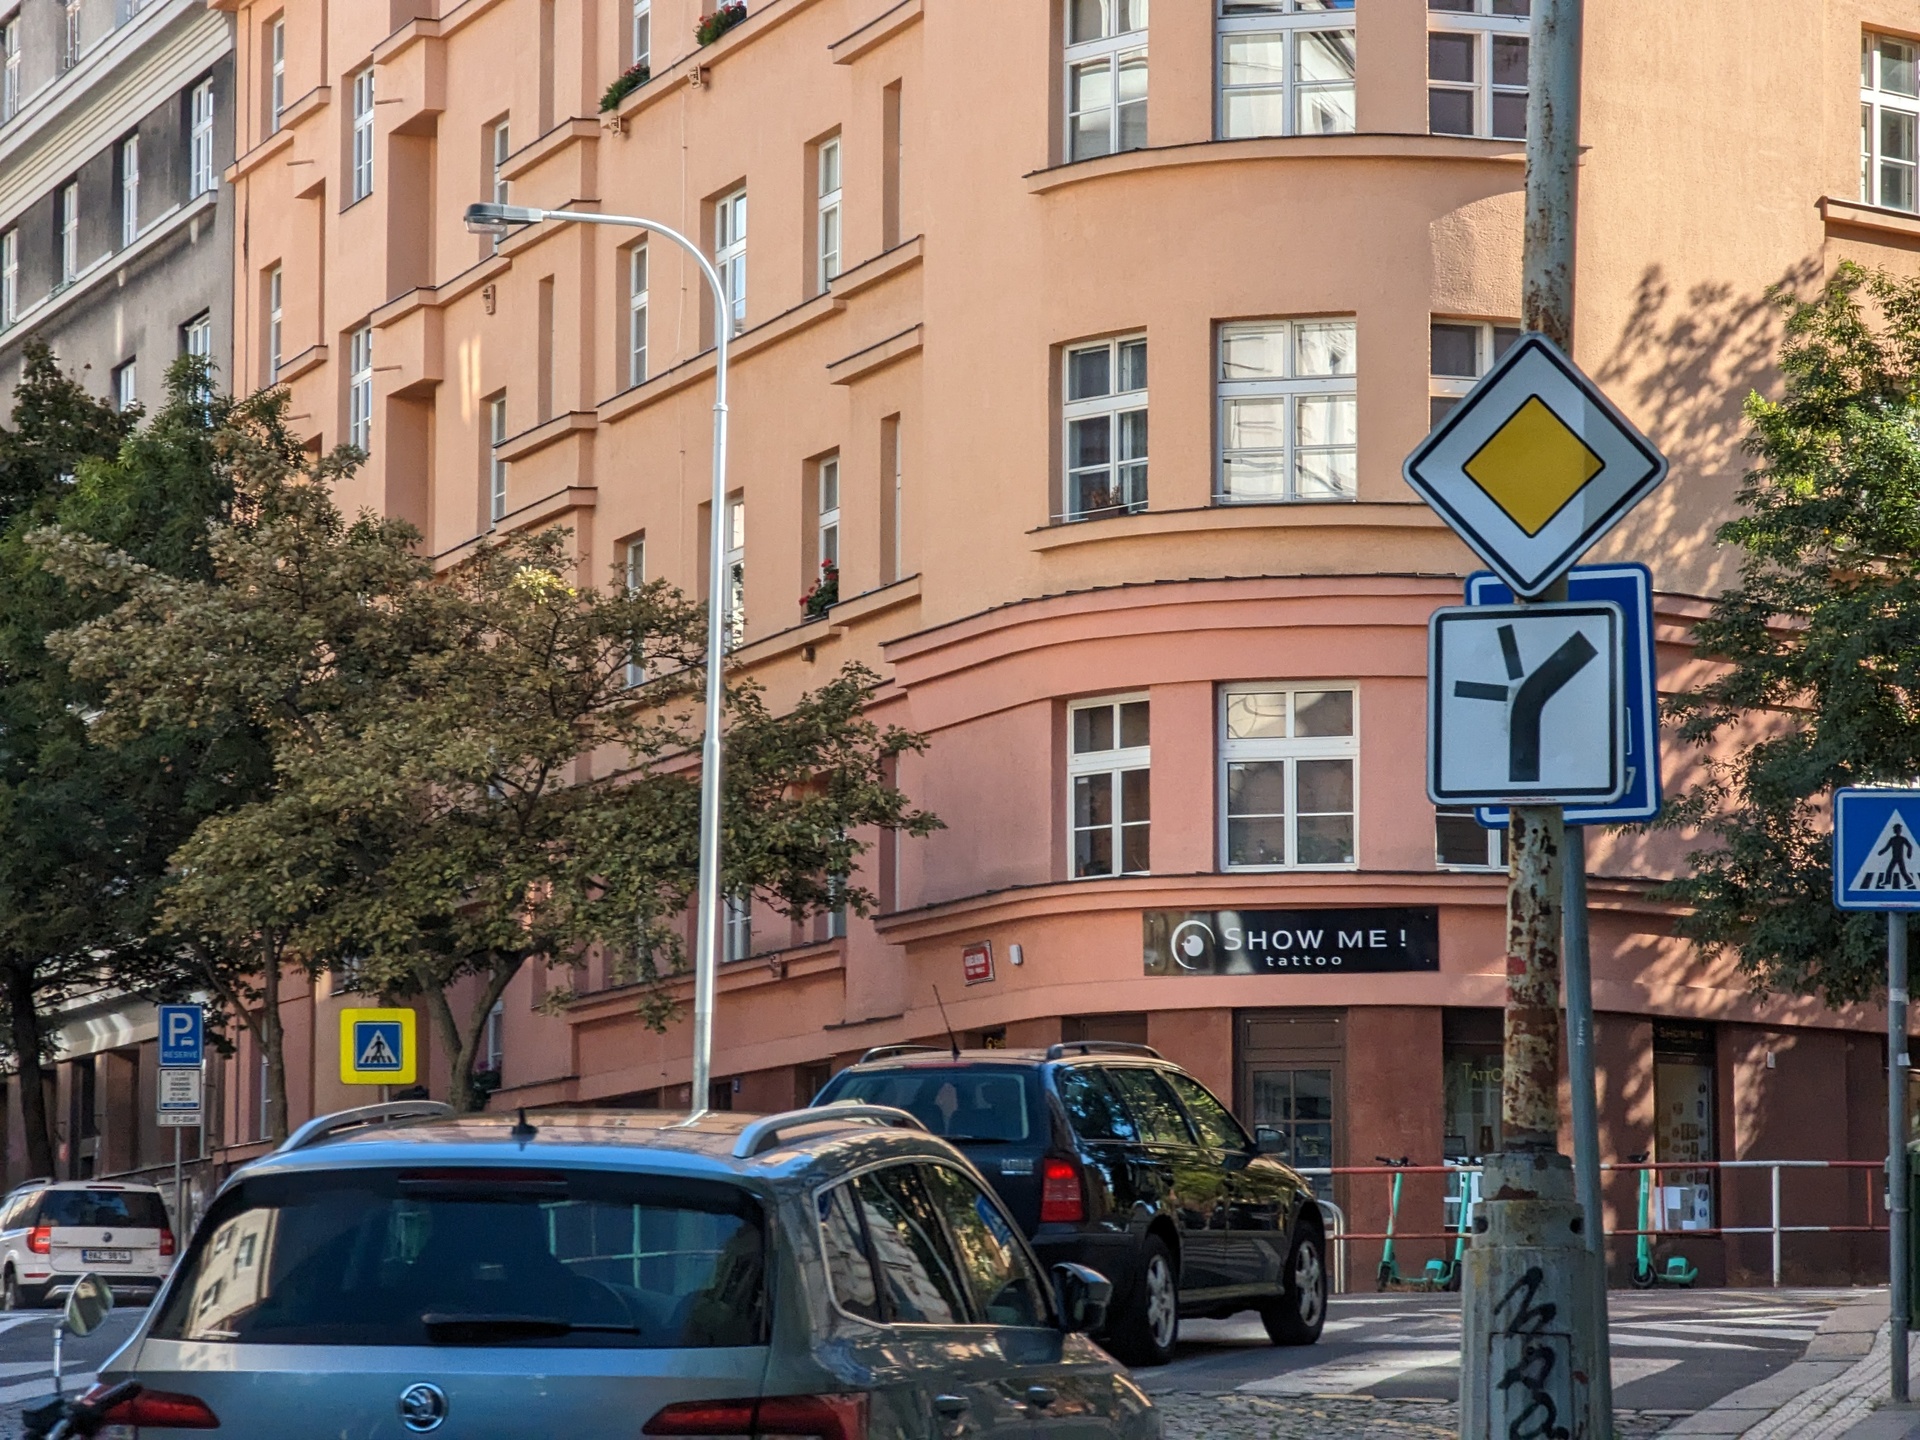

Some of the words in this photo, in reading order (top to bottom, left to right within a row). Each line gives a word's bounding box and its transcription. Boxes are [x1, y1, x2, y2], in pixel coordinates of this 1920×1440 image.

[1224, 927, 1324, 951] SHOW
[1338, 929, 1388, 948] ME
[1400, 929, 1407, 947] !
[1266, 955, 1342, 967] tattoo
[169, 1013, 193, 1047] P
